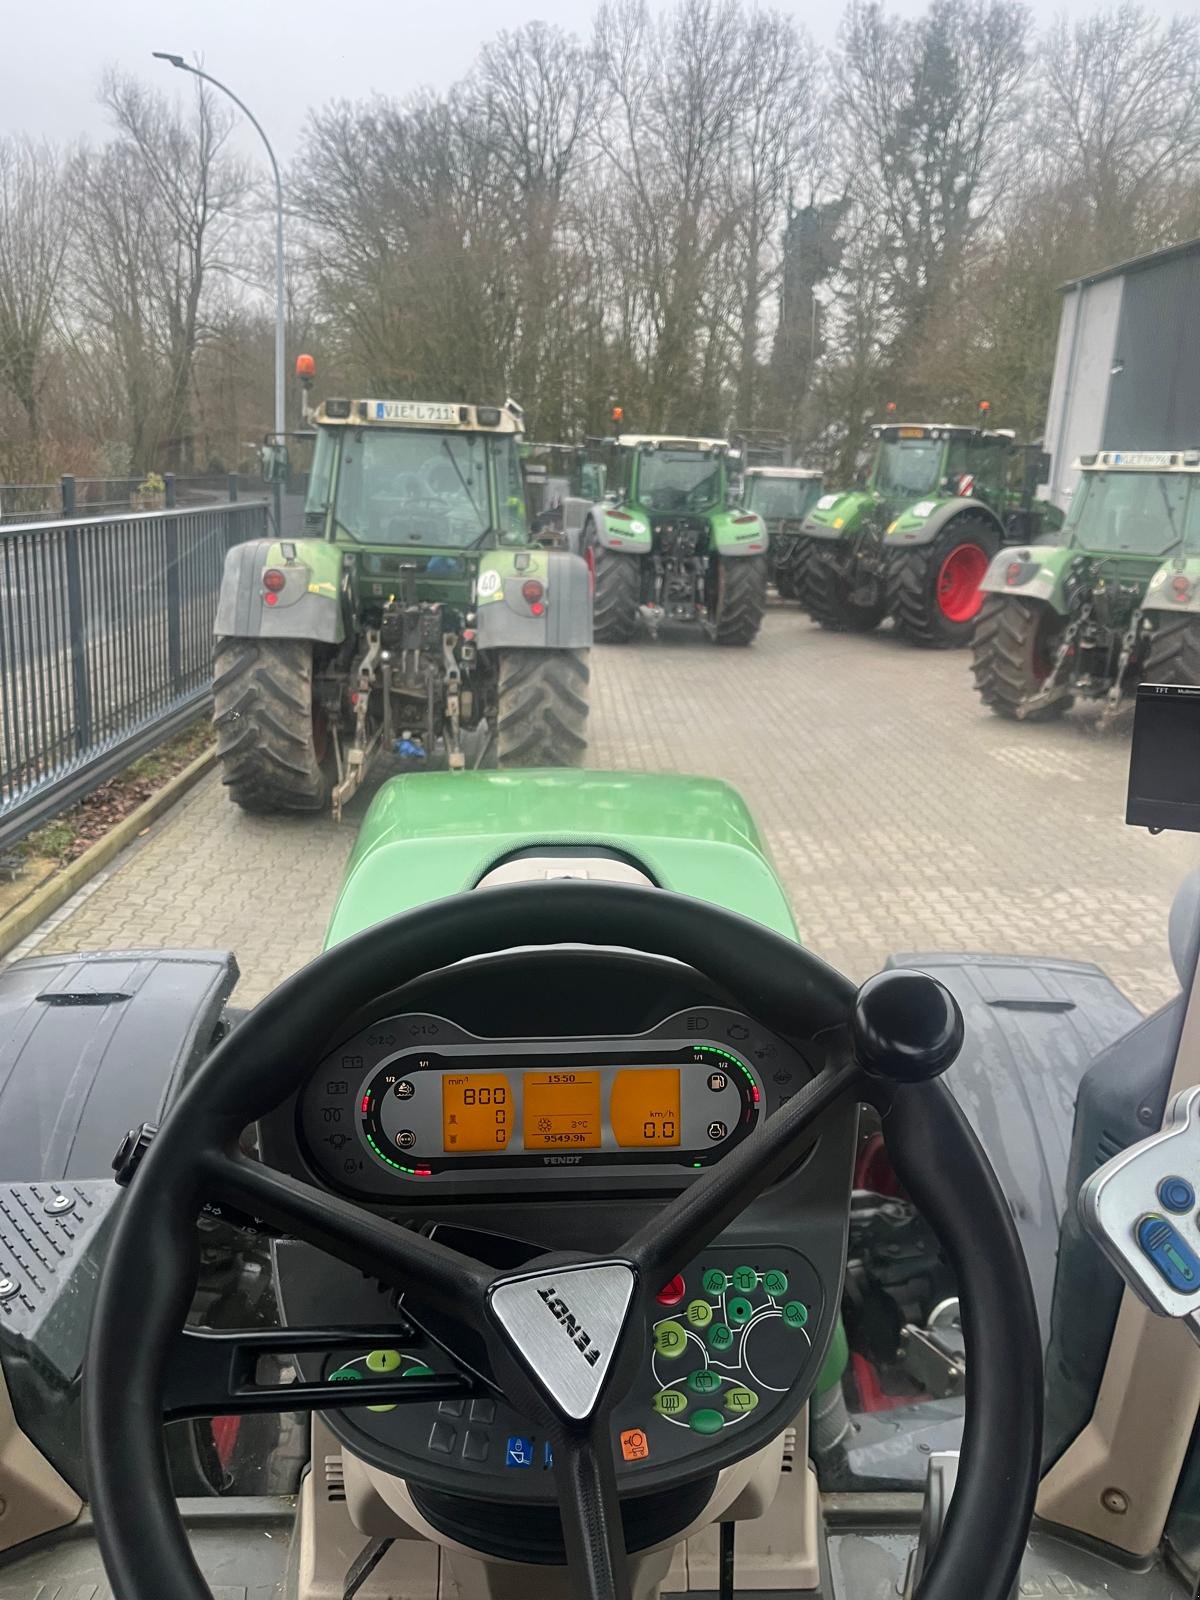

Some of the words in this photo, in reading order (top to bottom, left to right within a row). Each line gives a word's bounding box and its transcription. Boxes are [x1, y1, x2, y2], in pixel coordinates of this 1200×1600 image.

[384, 404, 409, 419] VIE
[481, 574, 497, 592] 40
[463, 1087, 506, 1106] 800
[495, 1109, 506, 1124] 0
[649, 1110, 675, 1119] km/h
[495, 1128, 506, 1143] 0
[643, 1121, 675, 1139] 0.0
[543, 1156, 583, 1165] FENDT
[536, 1287, 602, 1369] FENDT
